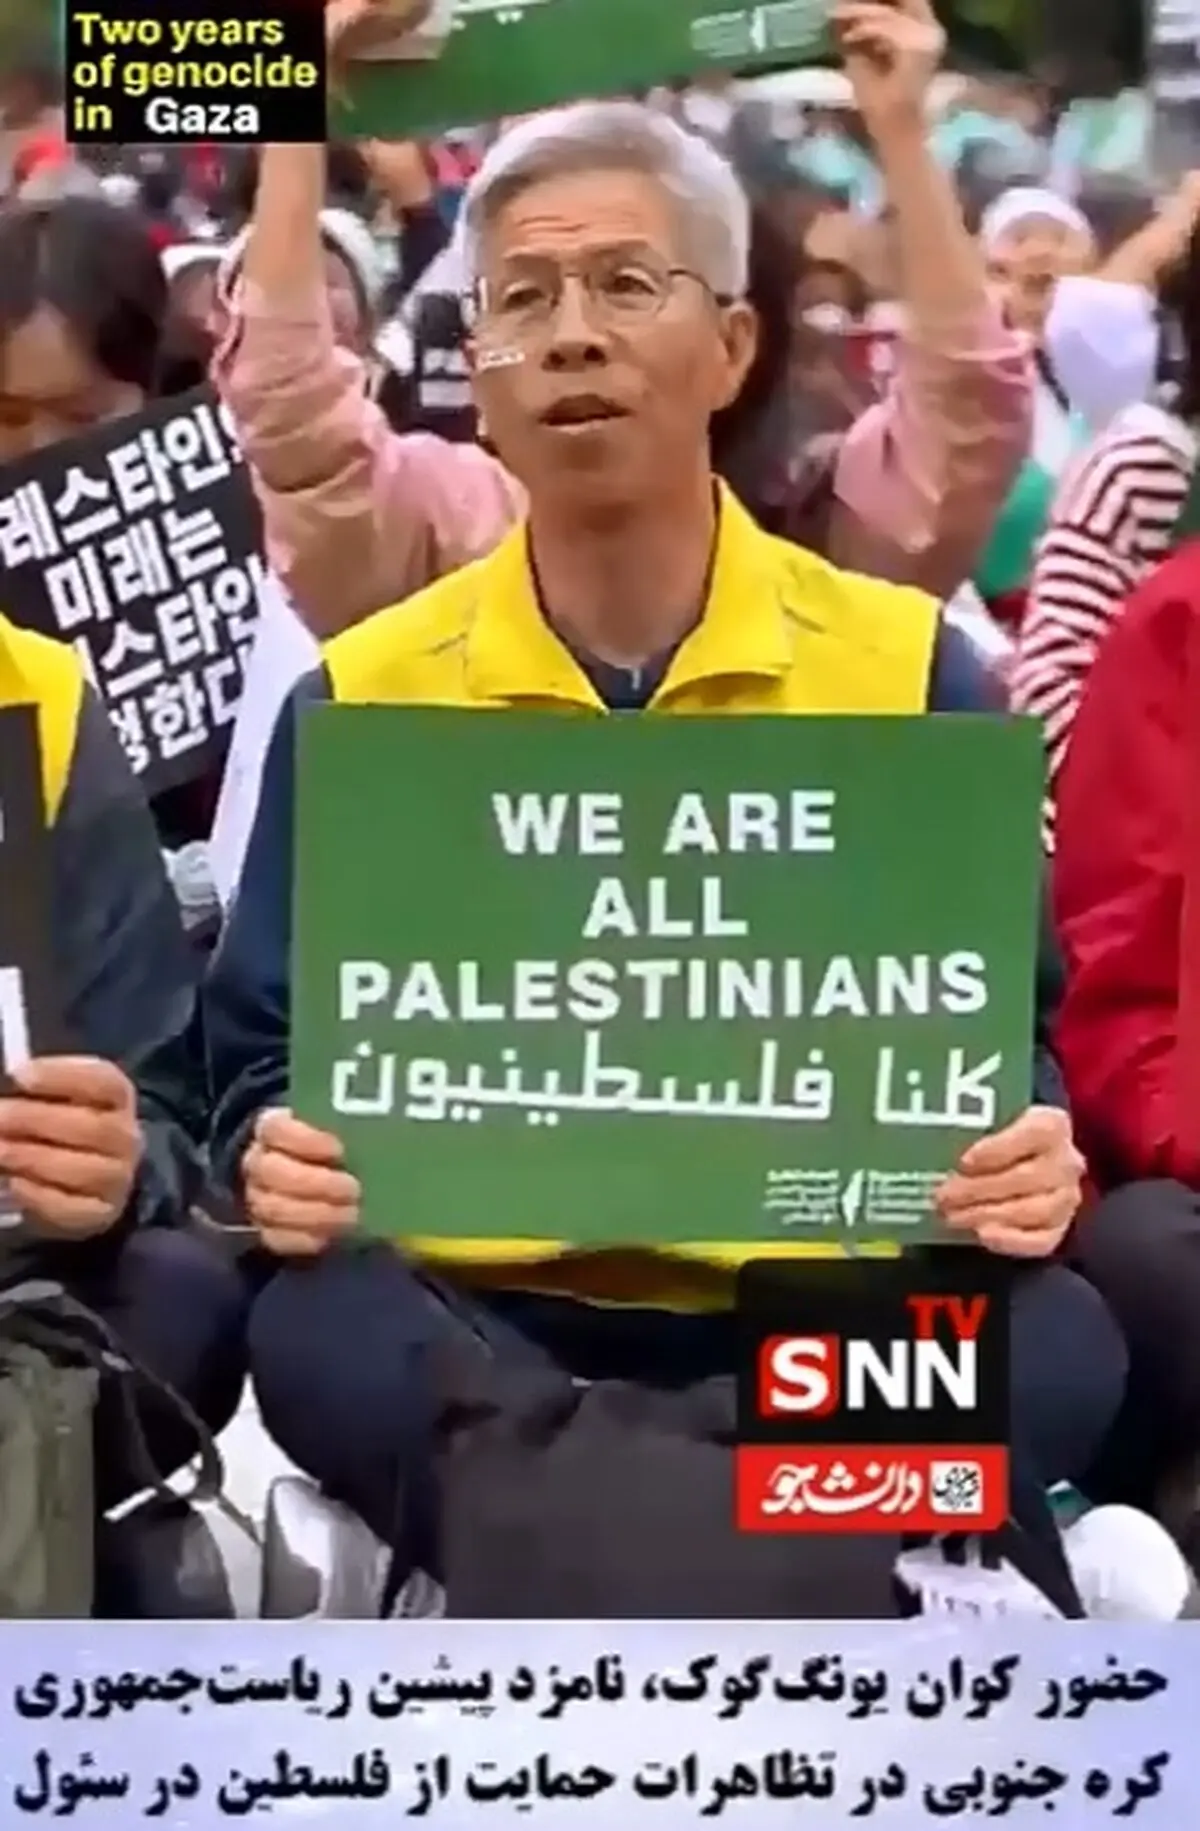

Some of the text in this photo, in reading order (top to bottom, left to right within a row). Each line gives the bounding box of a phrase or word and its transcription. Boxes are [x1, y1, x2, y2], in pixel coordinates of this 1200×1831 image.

[44, 508, 228, 630] 미래는
[74, 553, 264, 698] 스타인
[493, 790, 836, 855] WE ARE
[583, 877, 748, 938] ALL
[339, 951, 988, 1021] PALESTINIANS
[331, 1030, 1002, 1129] كلنا فلسطينيون
